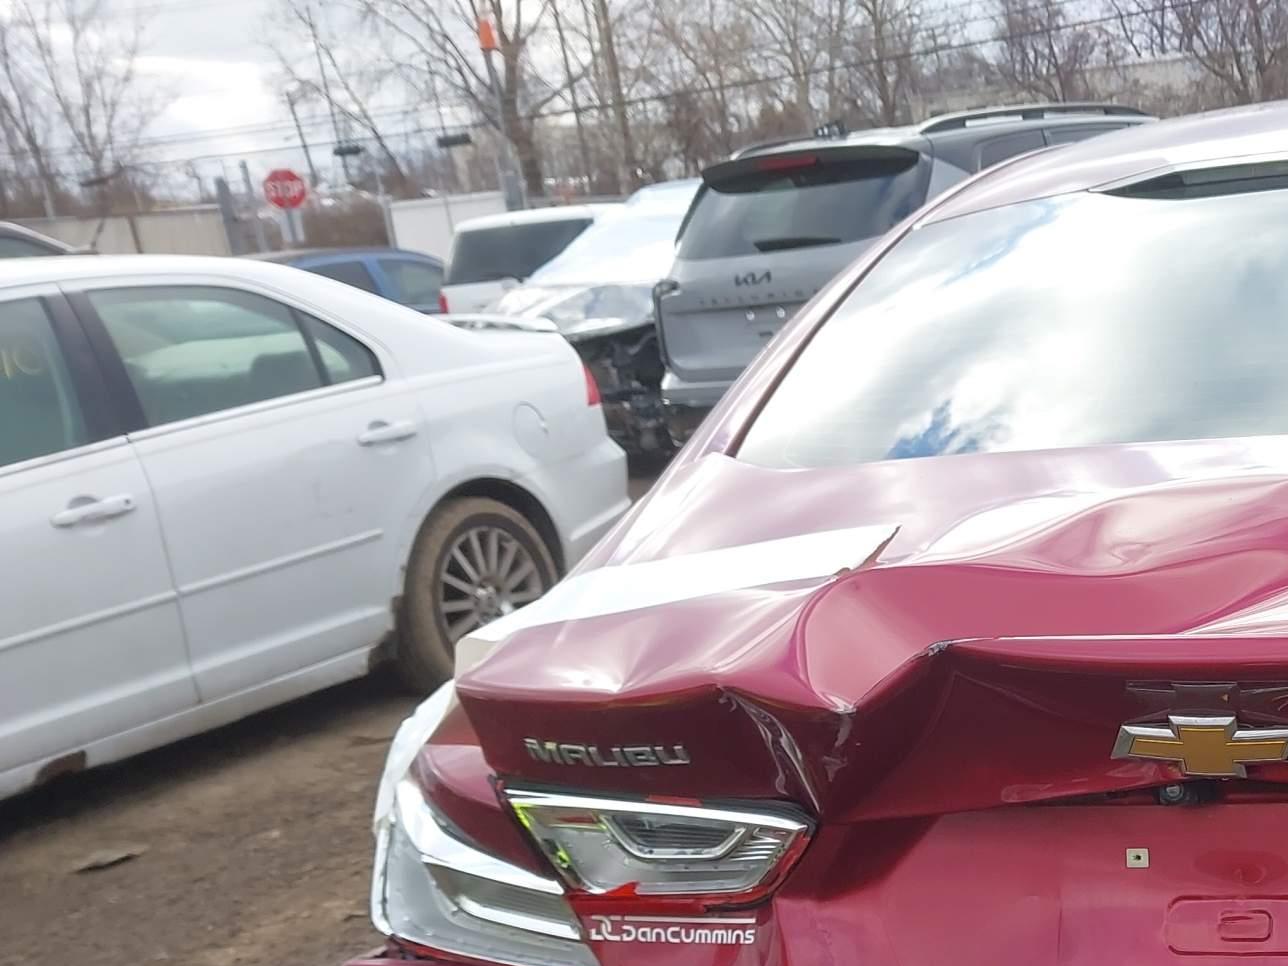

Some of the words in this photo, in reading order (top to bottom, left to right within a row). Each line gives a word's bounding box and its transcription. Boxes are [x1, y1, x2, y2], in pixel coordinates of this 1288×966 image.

[265, 181, 303, 198] STOP
[734, 270, 772, 287] KIA
[523, 738, 691, 767] MALIBU
